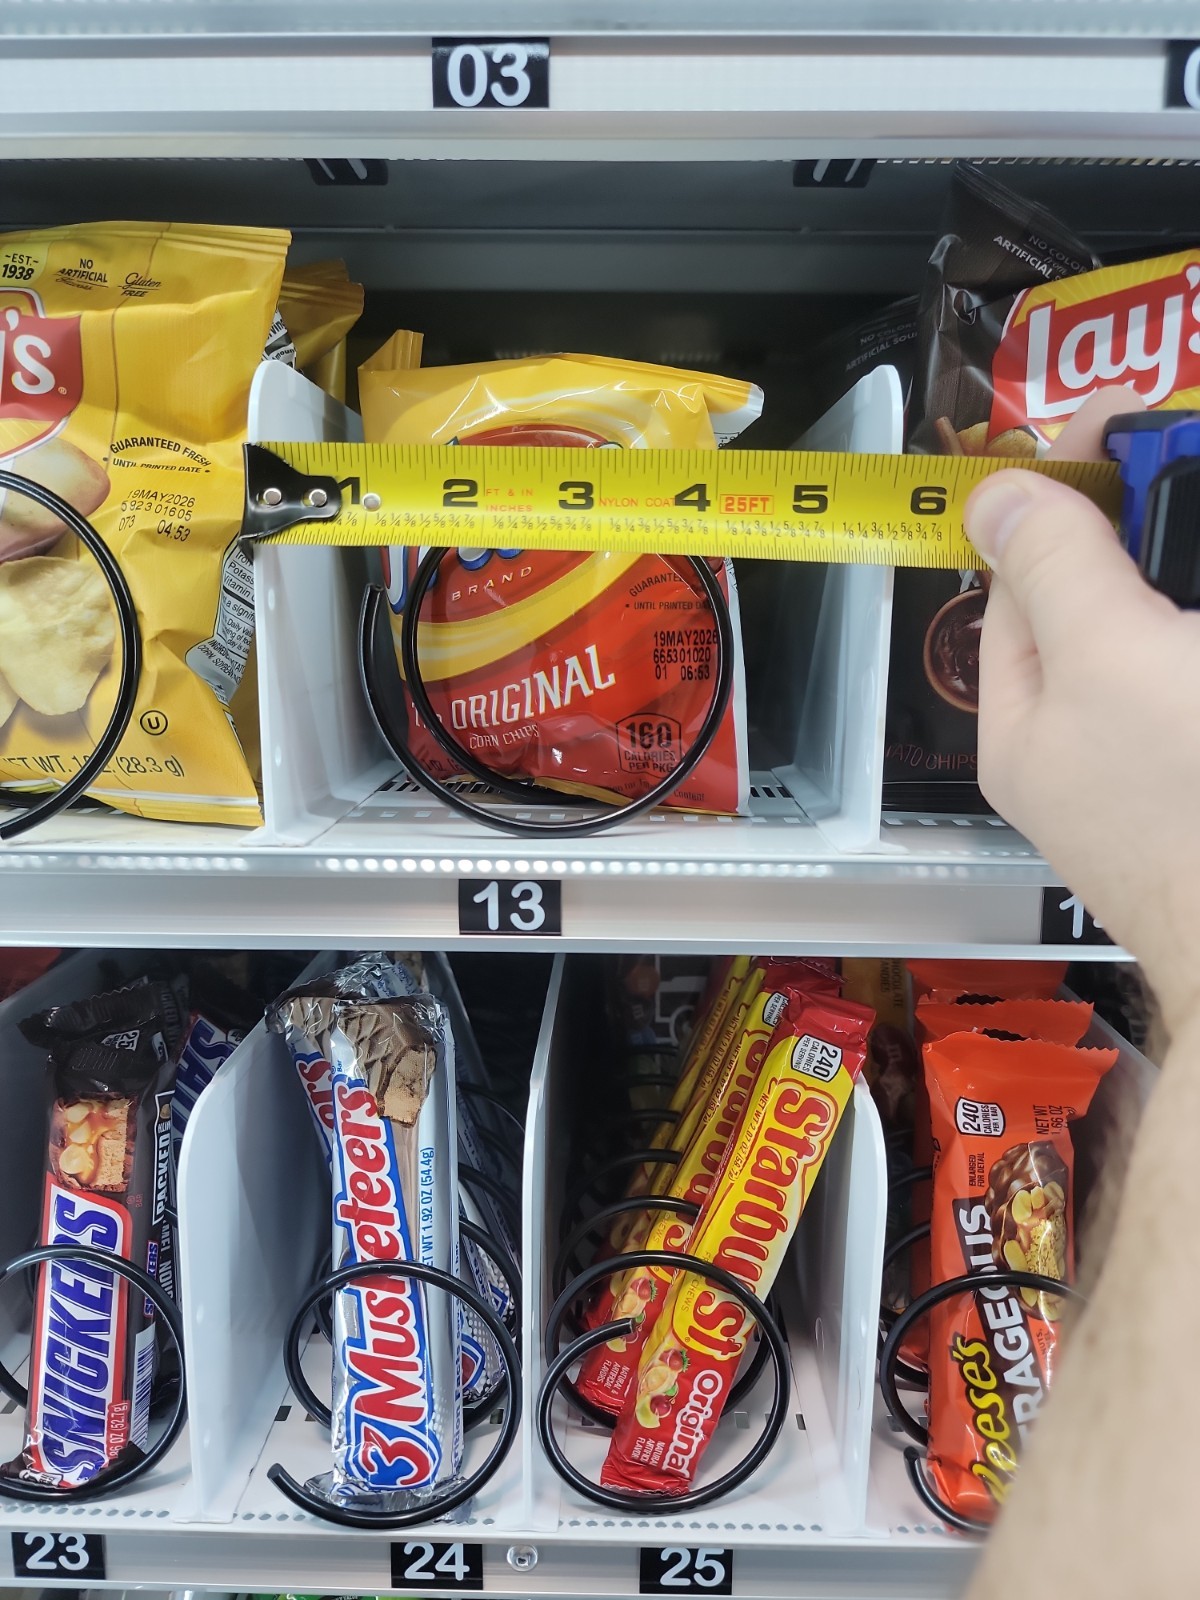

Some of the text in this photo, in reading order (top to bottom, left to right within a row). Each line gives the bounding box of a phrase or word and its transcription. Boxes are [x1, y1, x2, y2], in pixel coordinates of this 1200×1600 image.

[447, 44, 531, 107] 03
[79, 258, 94, 270] NO
[993, 235, 1054, 279] ARTIFICIAL
[1028, 235, 1088, 273] NO COLOR
[2, 264, 35, 281] 1938
[57, 268, 108, 283] ARTIFICIAL
[122, 272, 162, 289] Gluten
[121, 289, 148, 298] FREE
[845, 341, 891, 372] ARTIFICIAL
[110, 436, 211, 467] GUARANTEED FRESH
[112, 458, 202, 474] UNTIL PRINTED DATE
[127, 489, 196, 508] 19MAY2026
[338, 477, 947, 515] 1 2 3 4 5 6
[486, 488, 534, 498] FT & IN
[598, 497, 638, 507] NYLON
[724, 496, 770, 513] 25FT
[485, 504, 533, 513] INCHES
[118, 514, 191, 542] 073 04:53
[228, 562, 254, 584] Potass
[452, 565, 532, 601] BRAND
[634, 602, 693, 610] UNTIL PRINTED
[653, 629, 718, 647] 19MAY2026
[653, 646, 711, 664] 665301020
[452, 644, 616, 730] ORIGINAL
[655, 664, 710, 681] 01 06:53
[469, 724, 541, 749] CORN CHIPS
[626, 721, 672, 749] 160
[32, 756, 73, 773] WT.
[73, 757, 80, 770] 1
[116, 757, 161, 777] (28.3
[165, 755, 186, 778] g)
[624, 750, 676, 764] CALORIES
[629, 761, 675, 774] PER PKG
[887, 743, 923, 767] ATO
[473, 881, 545, 930] 13
[1059, 894, 1104, 938] 1
[802, 1037, 811, 1048] PER
[802, 1040, 820, 1073] CALORIES
[793, 1047, 807, 1070] SERVING
[812, 1044, 839, 1079] 240
[962, 1101, 981, 1132] 240
[981, 1104, 992, 1134] CALORIES
[1033, 1104, 1050, 1135] NET WT
[1049, 1105, 1063, 1117] OZ
[156, 1133, 170, 1216] PACKED
[968, 1154, 977, 1187] ENLARGED
[977, 1152, 985, 1187] FOR DETAIL
[420, 1147, 435, 1254] WT 1.92 OZ (54.4g)
[688, 1087, 833, 1356] Starbust
[143, 1241, 159, 1316] SNKERS
[680, 1279, 700, 1312] CHEWS
[960, 1203, 1047, 1437] RAGEUS
[42, 1194, 119, 1482] SNICKERS
[109, 1402, 127, 1444] OZ (52.7g)
[661, 1369, 723, 1478] Original
[360, 1425, 432, 1486] 3
[631, 1436, 646, 1459] FLAVOR
[24, 1532, 89, 1571] 23
[403, 1542, 470, 1581] 24
[660, 1547, 726, 1587] 25
